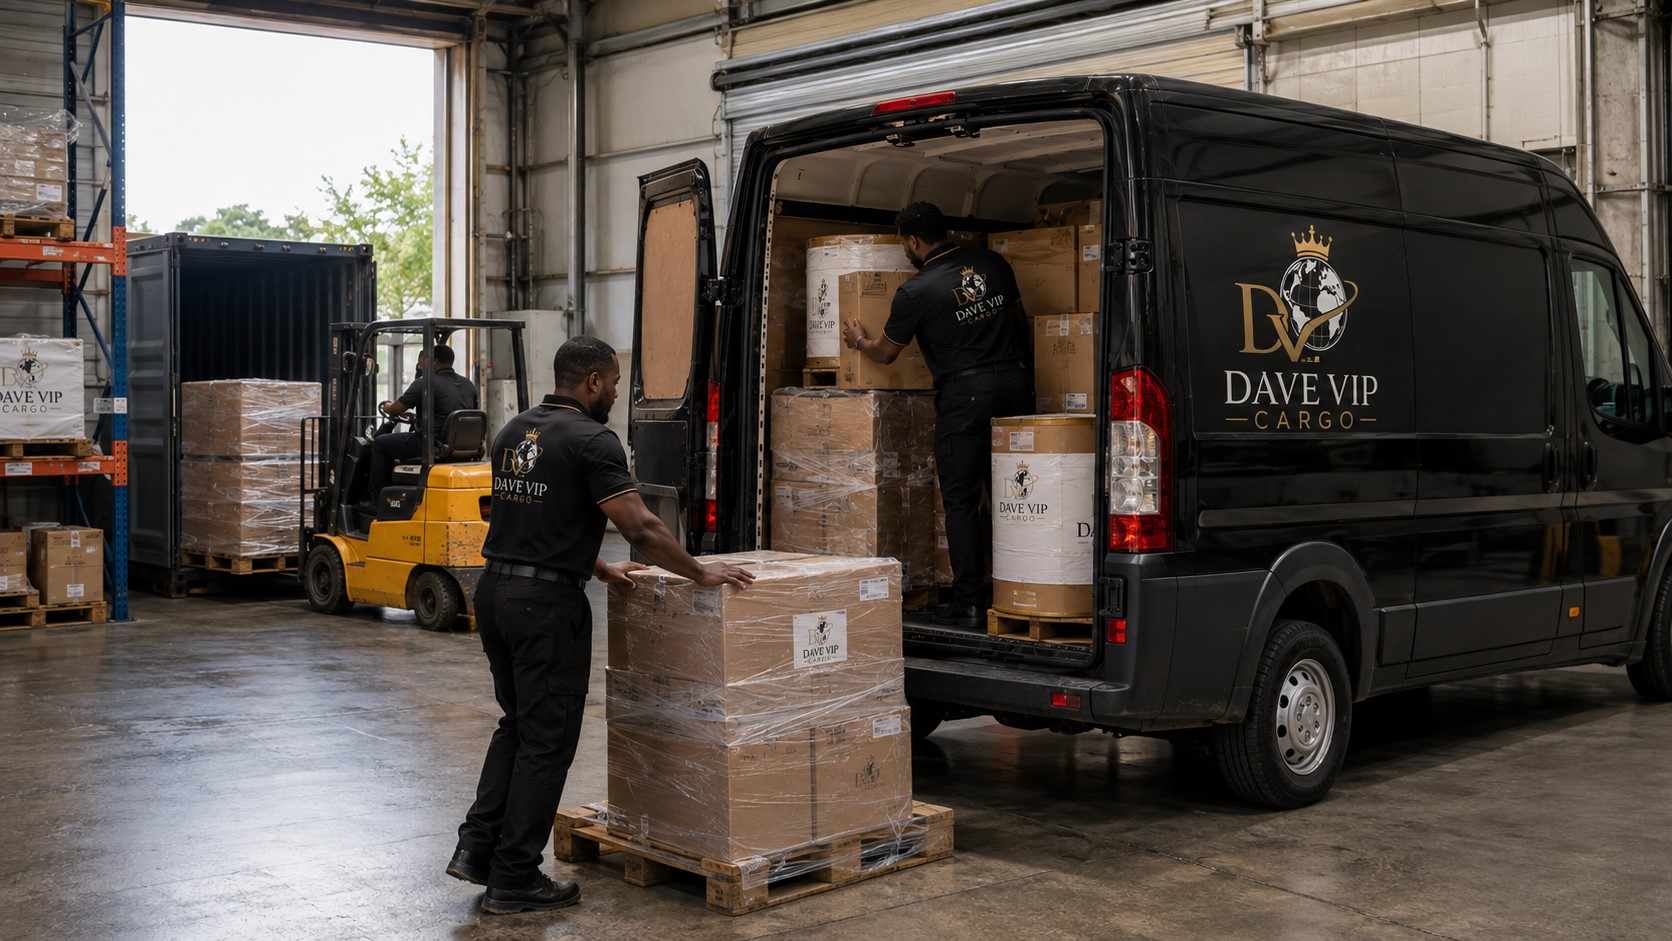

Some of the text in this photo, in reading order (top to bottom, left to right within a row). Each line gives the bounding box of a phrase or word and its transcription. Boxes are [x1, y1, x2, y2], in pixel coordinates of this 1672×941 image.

[955, 294, 1004, 321] DAVE VIP
[1224, 370, 1379, 406] DAVE VIP
[37, 390, 63, 404] VIP
[2, 404, 48, 414] CARGO
[1254, 410, 1354, 430] CARGO
[494, 476, 548, 497] DAVE VIP
[500, 492, 532, 505] CARGO
[1000, 502, 1048, 514] DAVE VIP
[803, 644, 839, 659] DAVE VIP
